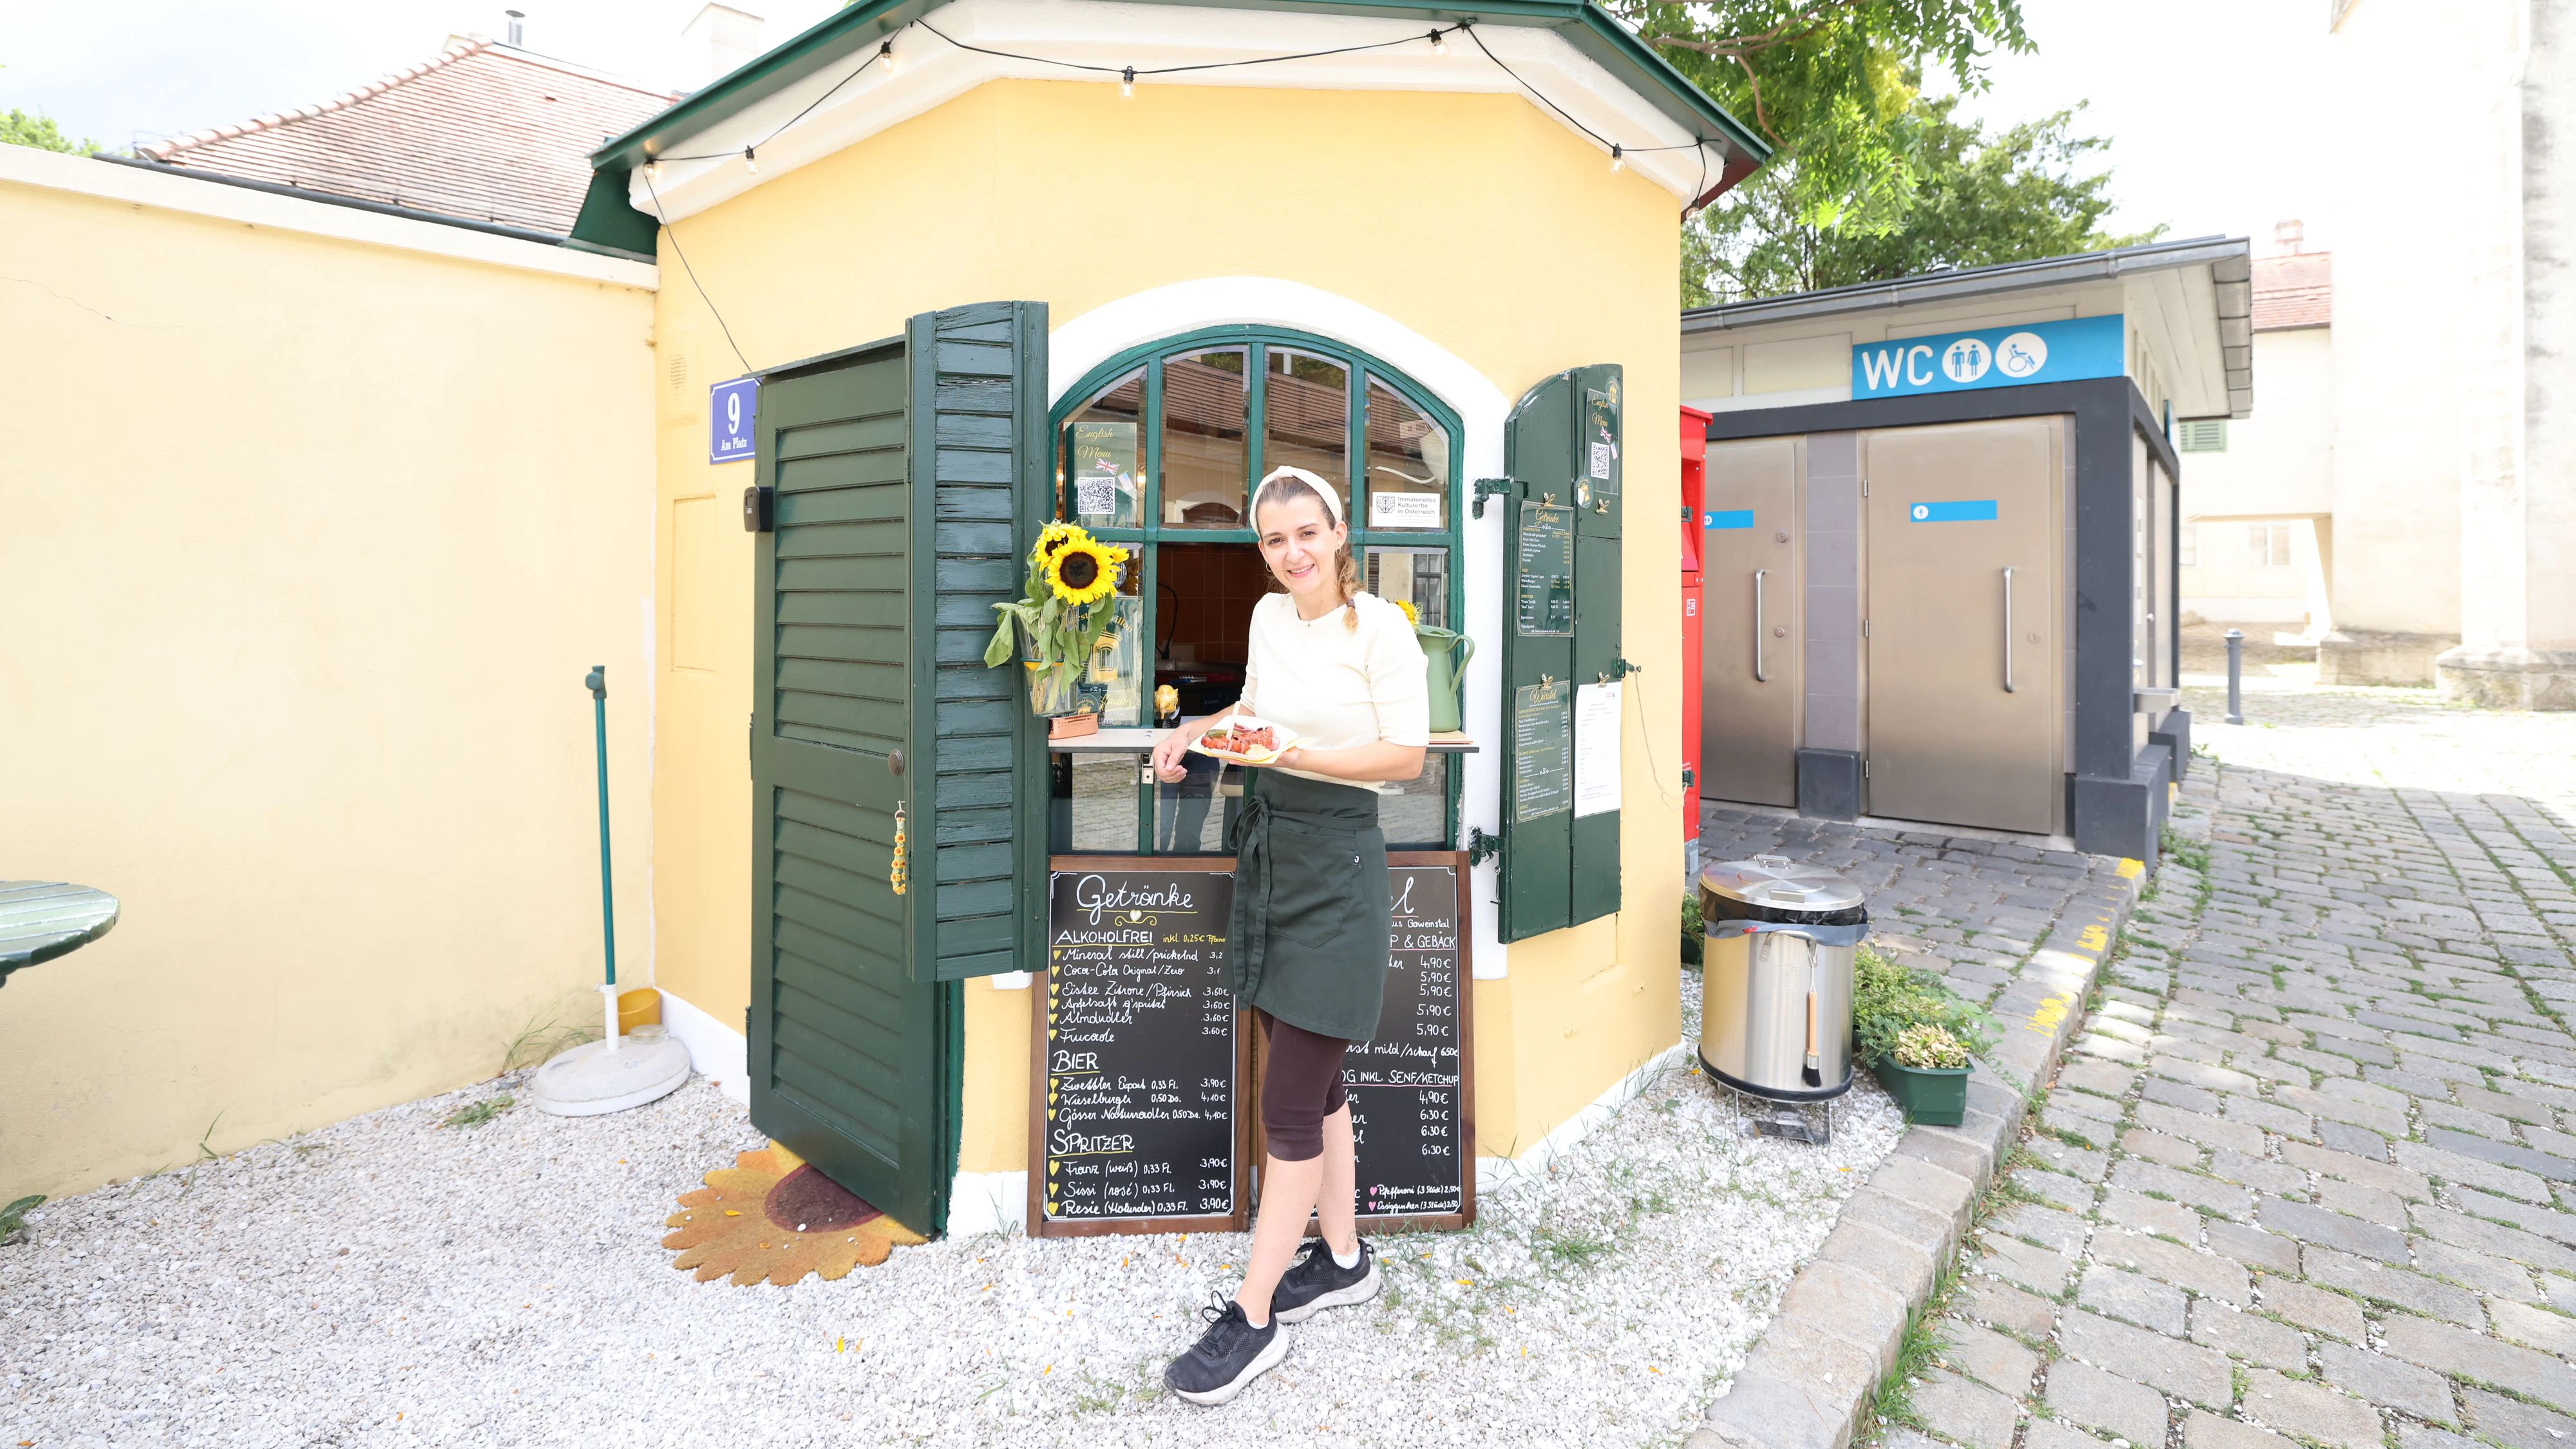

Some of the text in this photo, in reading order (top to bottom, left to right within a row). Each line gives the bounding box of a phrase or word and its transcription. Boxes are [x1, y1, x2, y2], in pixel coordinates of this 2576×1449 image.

[1861, 345, 1933, 390] WC
[1591, 393, 1609, 411] English
[728, 392, 740, 435] 9
[1591, 412, 1608, 427] Menu
[1075, 425, 1113, 442] English
[721, 437, 747, 451] Am Platz
[1077, 445, 1112, 458] Menu
[1535, 507, 1560, 526] Getränke
[1076, 874, 1193, 925] Getränke
[1407, 918, 1450, 928] Gaweinstal
[1055, 929, 1153, 945] ALKOHOLFREI
[1162, 933, 1180, 943] inkl.
[1404, 934, 1414, 949] &
[1417, 931, 1456, 949] GEBÄCK
[1063, 946, 1113, 961] Mineral
[1209, 951, 1223, 960] 3,2
[1063, 961, 1119, 976] Coca-Cola
[1062, 981, 1099, 996] Eistee
[1061, 998, 1117, 1016] Apfelsaft
[1122, 998, 1166, 1017] g'spritzt
[1059, 1011, 1133, 1025] Almdudler
[1059, 1027, 1115, 1043] Frucade
[1051, 1050, 1099, 1072] BIER
[1060, 1076, 1112, 1091] Zwettler
[1118, 1075, 1146, 1092] Export
[1151, 1080, 1167, 1090] 0,33
[1168, 1079, 1179, 1089] Fl.
[1360, 1070, 1383, 1083] INKL.
[1061, 1092, 1132, 1112] Wieselburger
[1059, 1107, 1097, 1131] Gösser
[1101, 1107, 1170, 1120] Naturradler
[1050, 1128, 1135, 1155] SPRITZER
[1062, 1160, 1100, 1177] Franz
[1105, 1160, 1139, 1178] (weiß)
[1143, 1164, 1160, 1175] 0,33
[1162, 1162, 1172, 1174] Fl.
[1063, 1181, 1097, 1198] Sissi
[1104, 1181, 1139, 1199] (rosé)
[1142, 1185, 1160, 1194] 0,33
[1163, 1182, 1175, 1193] Fl.
[1377, 1184, 1415, 1200] Pfefferoni
[1417, 1186, 1425, 1195] (3
[1061, 1200, 1101, 1215] Resie
[1104, 1200, 1155, 1215] (Holunder)
[1157, 1202, 1176, 1212] 0,33
[1177, 1200, 1188, 1211] Fl.
[1420, 1201, 1427, 1210] (3
